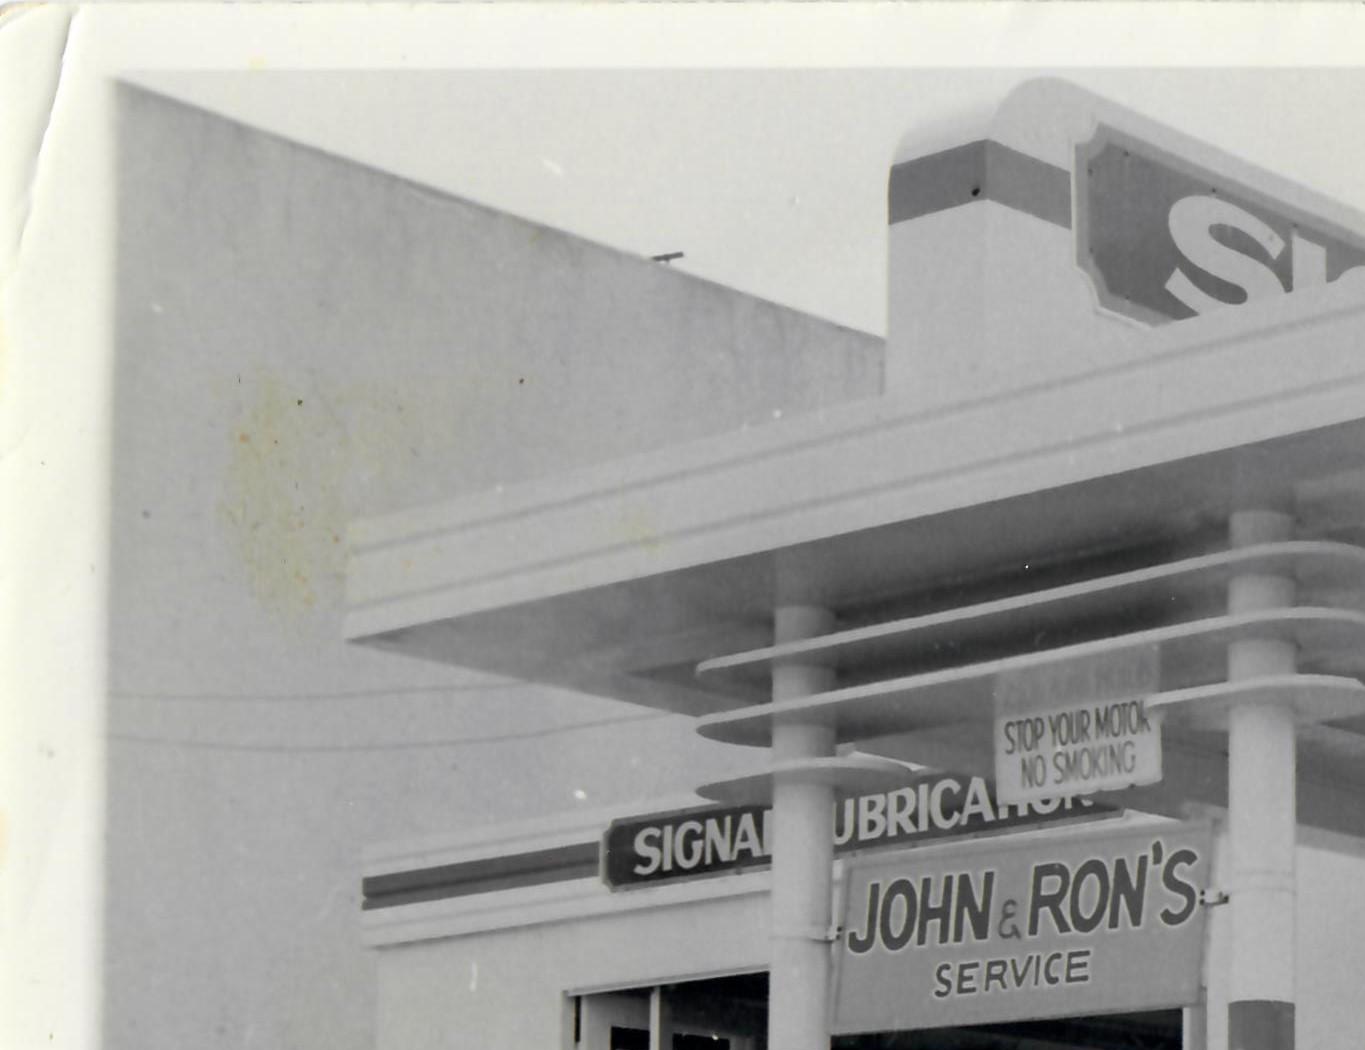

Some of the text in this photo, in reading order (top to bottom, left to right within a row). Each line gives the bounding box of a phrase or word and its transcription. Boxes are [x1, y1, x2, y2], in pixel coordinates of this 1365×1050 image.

[1004, 717, 1045, 755] STOP
[1048, 709, 1091, 746] YOUR
[1021, 740, 1136, 789] NO SMOKING
[848, 840, 1199, 954] JOHN & RON'S
[933, 949, 1092, 998] SERVICE
